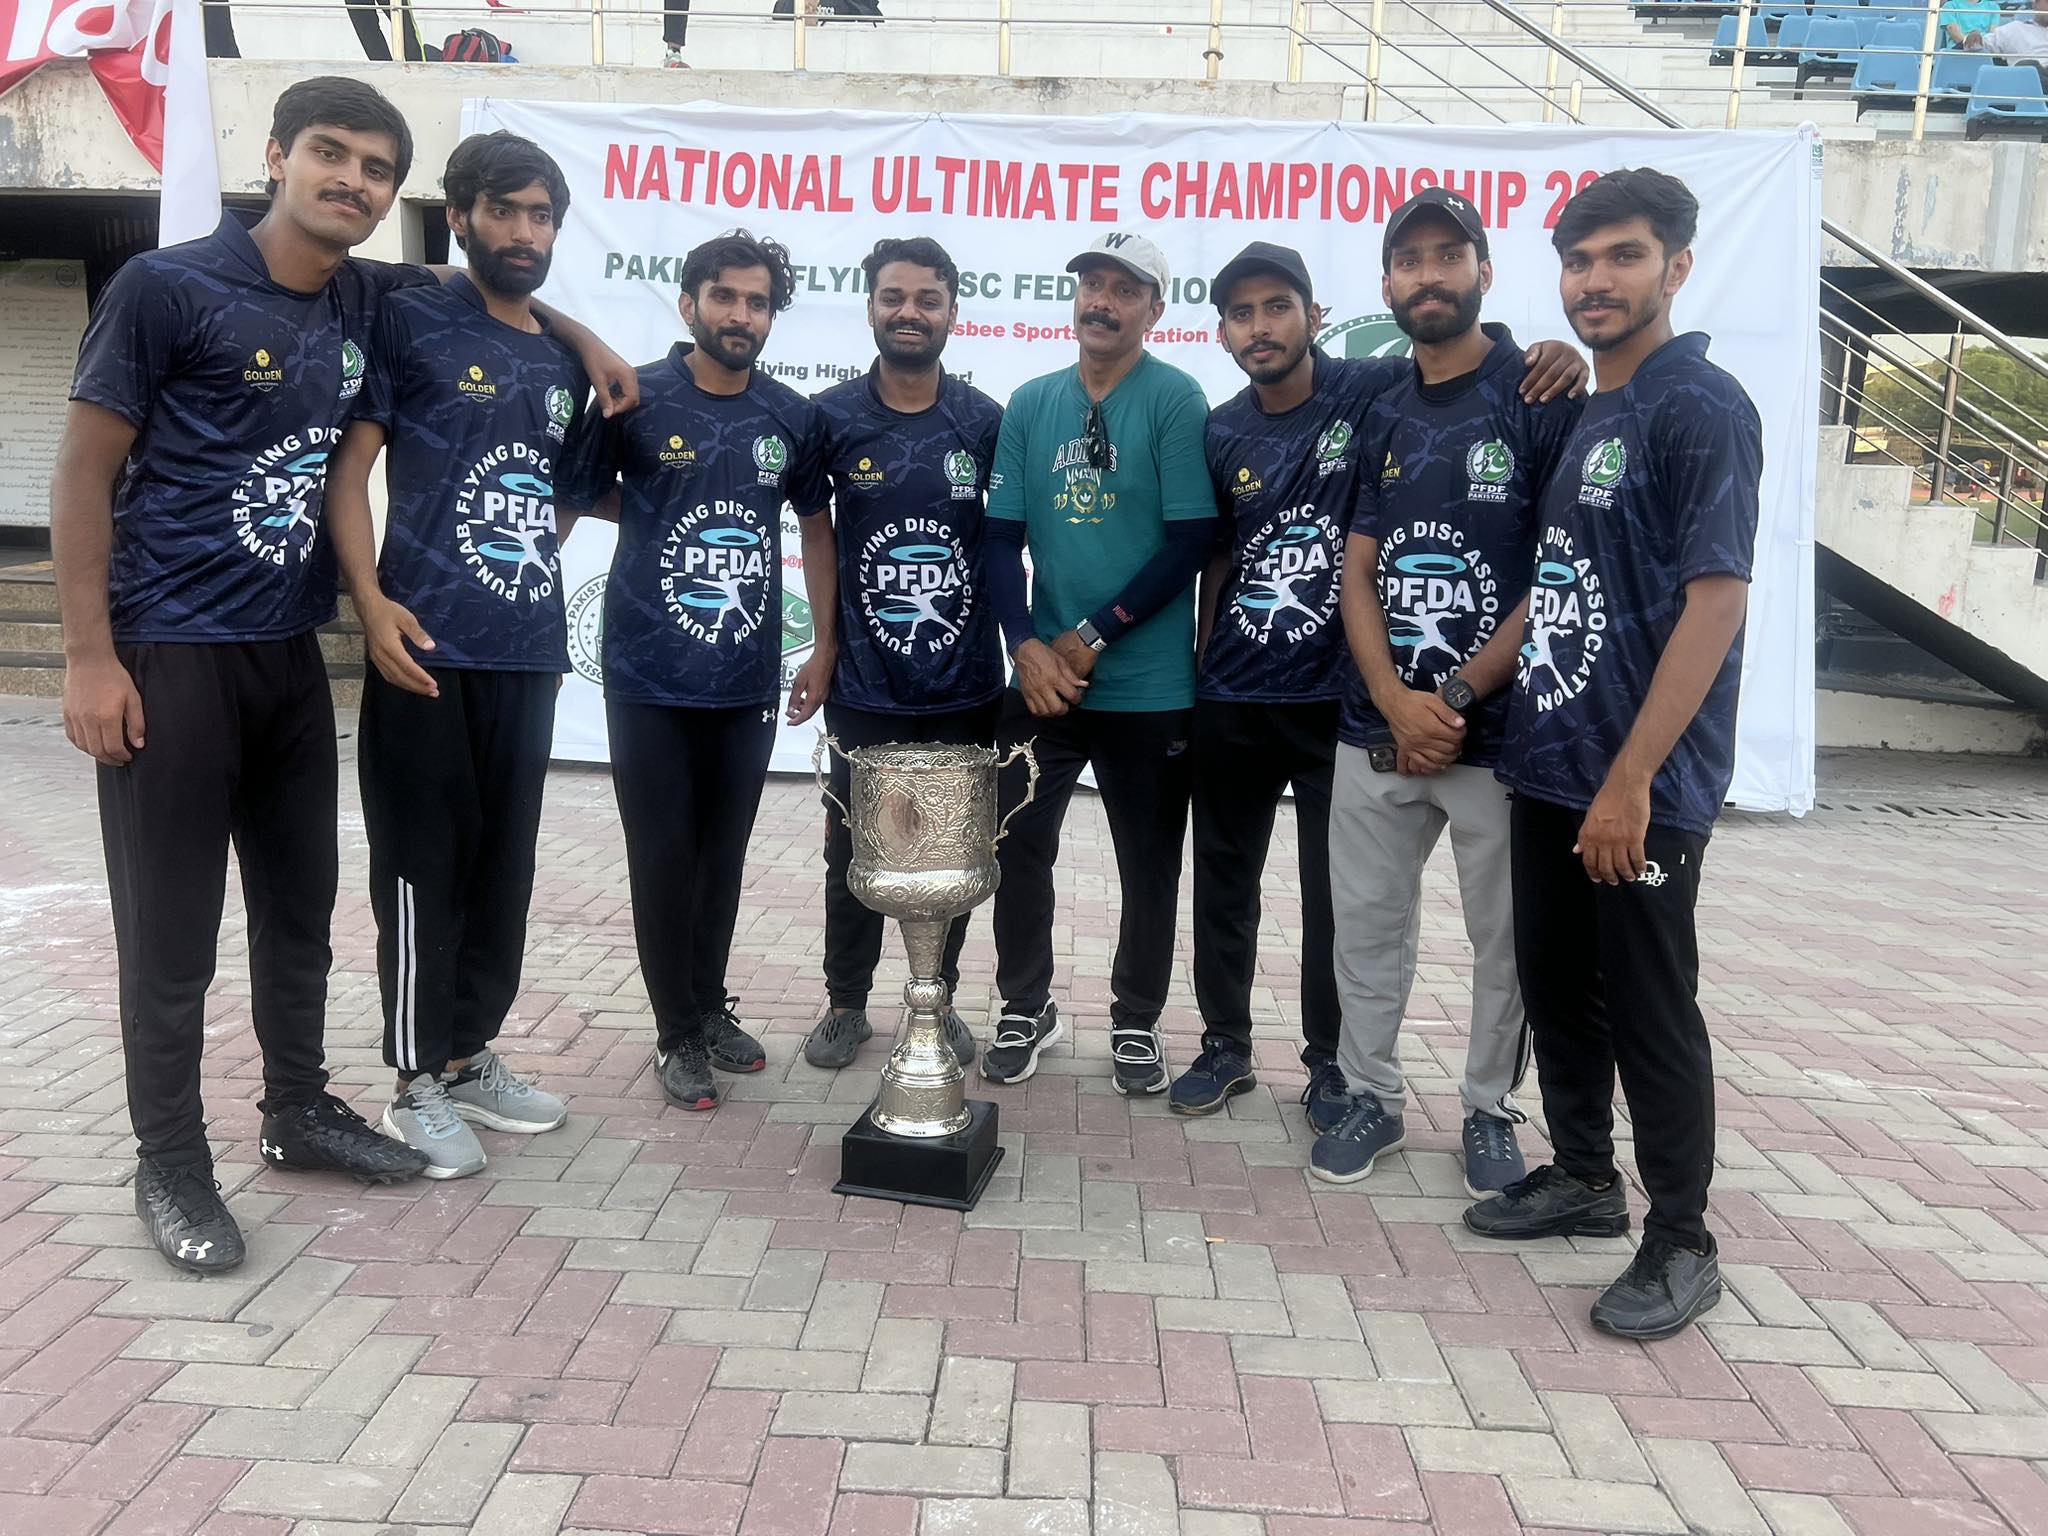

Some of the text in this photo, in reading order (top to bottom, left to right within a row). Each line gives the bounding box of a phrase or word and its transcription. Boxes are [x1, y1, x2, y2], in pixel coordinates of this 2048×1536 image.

[604, 144, 853, 212] NATIONAL
[871, 156, 1120, 222] ULTIMATE
[1105, 232, 1133, 249] W
[244, 369, 282, 381] GOLDEN
[815, 363, 862, 381] High
[458, 381, 496, 395] GOLDEN
[659, 450, 695, 461] GOLDEN
[456, 444, 509, 515] FLYING
[1232, 480, 1261, 495] GOLDEN
[1470, 483, 1506, 493] PFDF
[1580, 484, 1614, 498] PFDF
[715, 500, 757, 524] DISC
[660, 504, 709, 569] FLYING
[905, 518, 951, 539] DISC
[1414, 521, 1464, 548] DISC
[1546, 526, 1574, 556] DISC
[456, 523, 518, 602] PUNJAB
[684, 546, 764, 577] PFDA
[860, 523, 898, 584] FLYING
[876, 563, 962, 590] PFDA
[1387, 577, 1476, 612] PFDA
[660, 576, 719, 645] PUNJAB
[861, 591, 913, 656] PUNJAB
